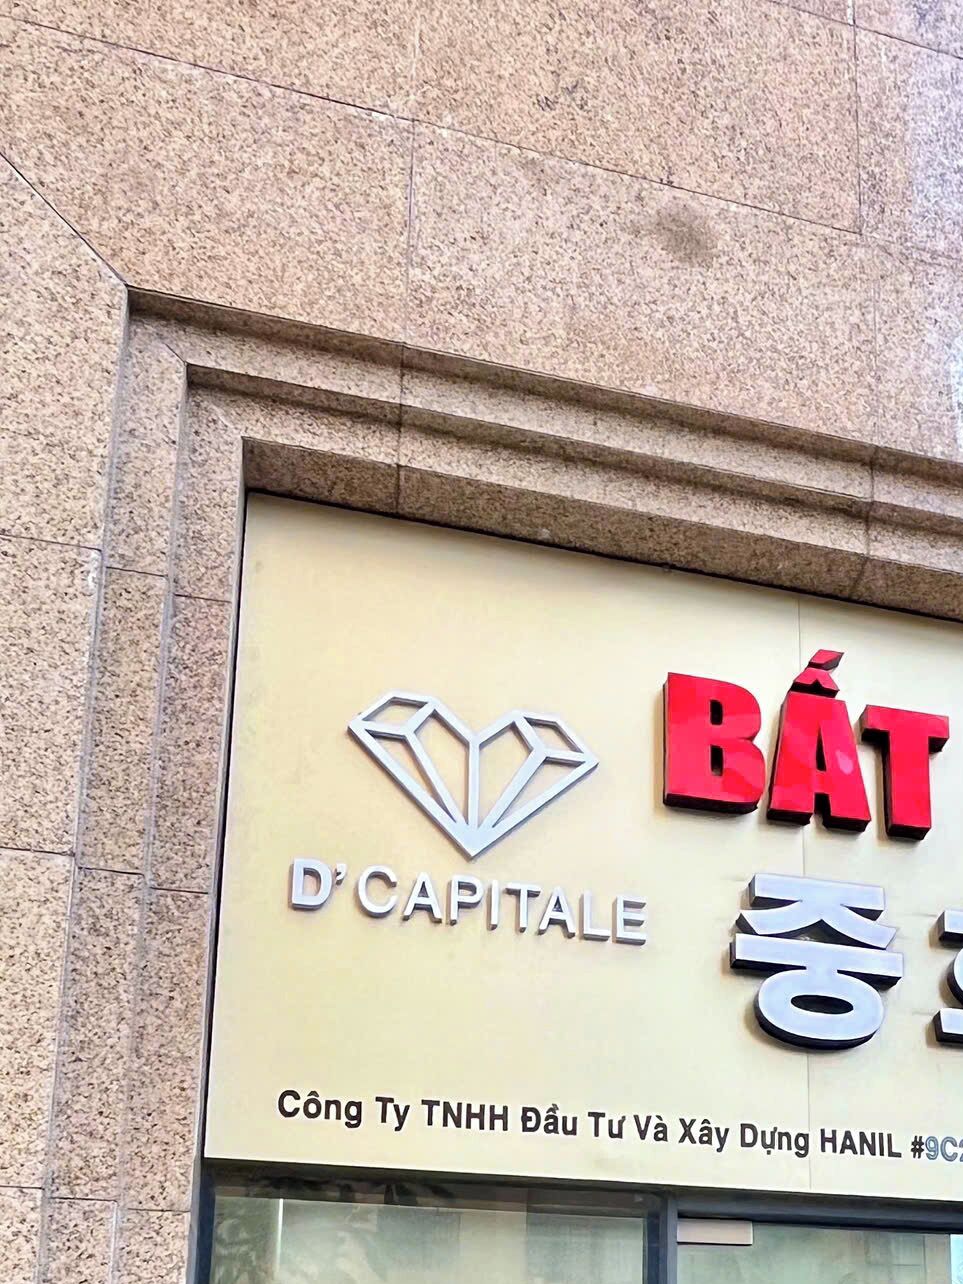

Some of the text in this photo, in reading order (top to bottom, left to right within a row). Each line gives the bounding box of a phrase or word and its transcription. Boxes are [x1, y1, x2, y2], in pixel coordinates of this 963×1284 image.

[662, 649, 948, 840] BẤT
[277, 1089, 363, 1128] Công
[375, 1097, 411, 1132] Ty
[421, 1099, 509, 1132] TNHH
[520, 1103, 578, 1136] Đầu
[588, 1112, 626, 1140] Tư
[634, 1114, 668, 1143] Và
[678, 1117, 730, 1153] Xây
[740, 1122, 809, 1158] Dựng
[820, 1128, 902, 1158] HANIL
